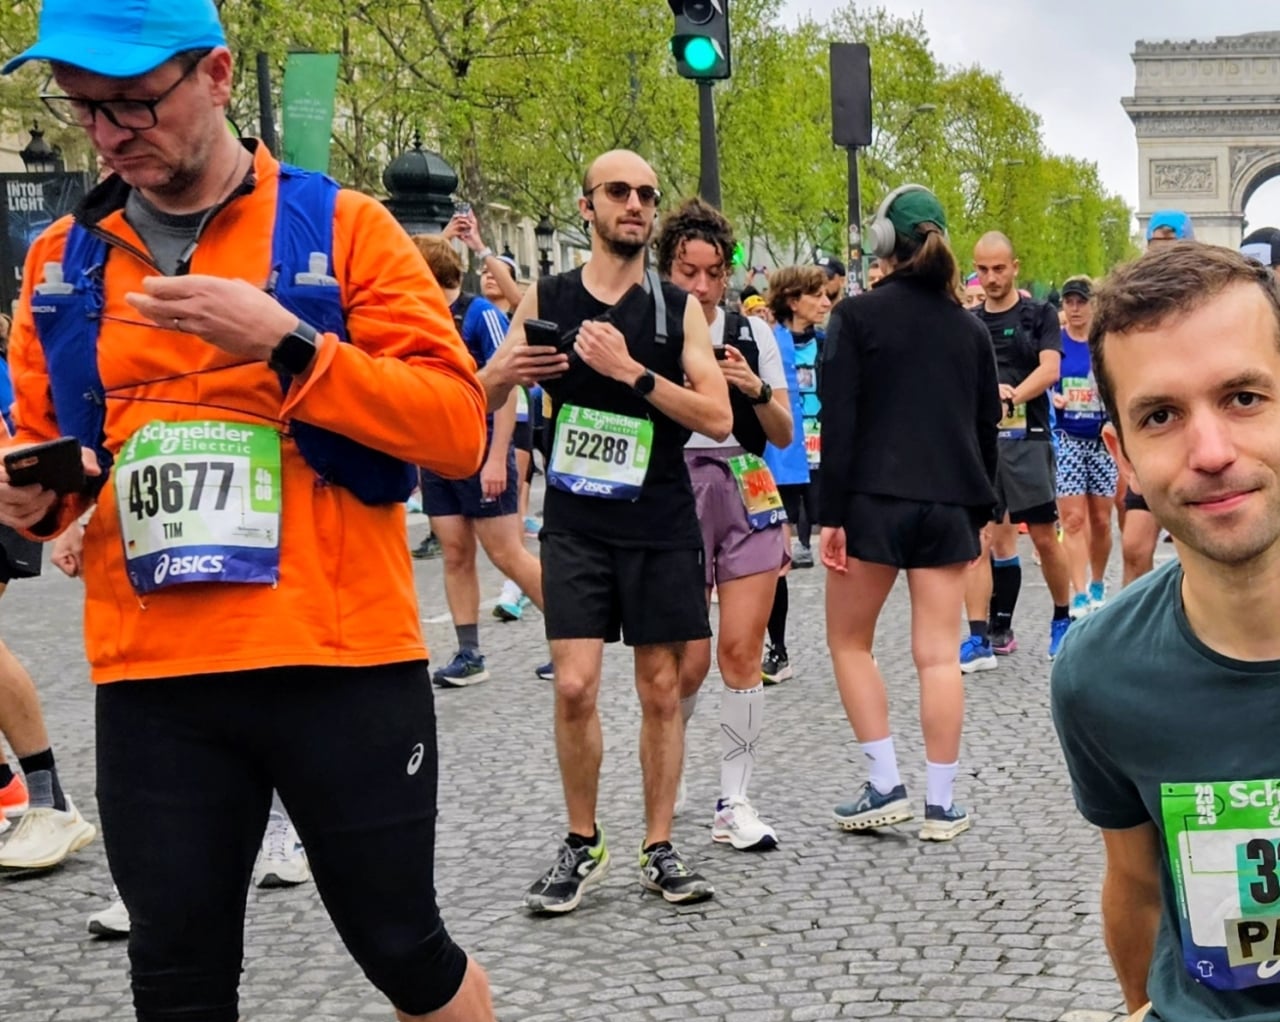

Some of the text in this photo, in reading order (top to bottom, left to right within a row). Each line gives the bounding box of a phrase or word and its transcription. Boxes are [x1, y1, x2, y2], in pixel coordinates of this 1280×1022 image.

[6, 182, 36, 197] INTO
[8, 197, 45, 211] LIGHT
[581, 408, 642, 429] Schneider
[141, 421, 254, 443] Schneider
[182, 439, 251, 454] Electric
[565, 429, 628, 465] 52288
[129, 461, 235, 520] 43677
[162, 522, 183, 540] TIM
